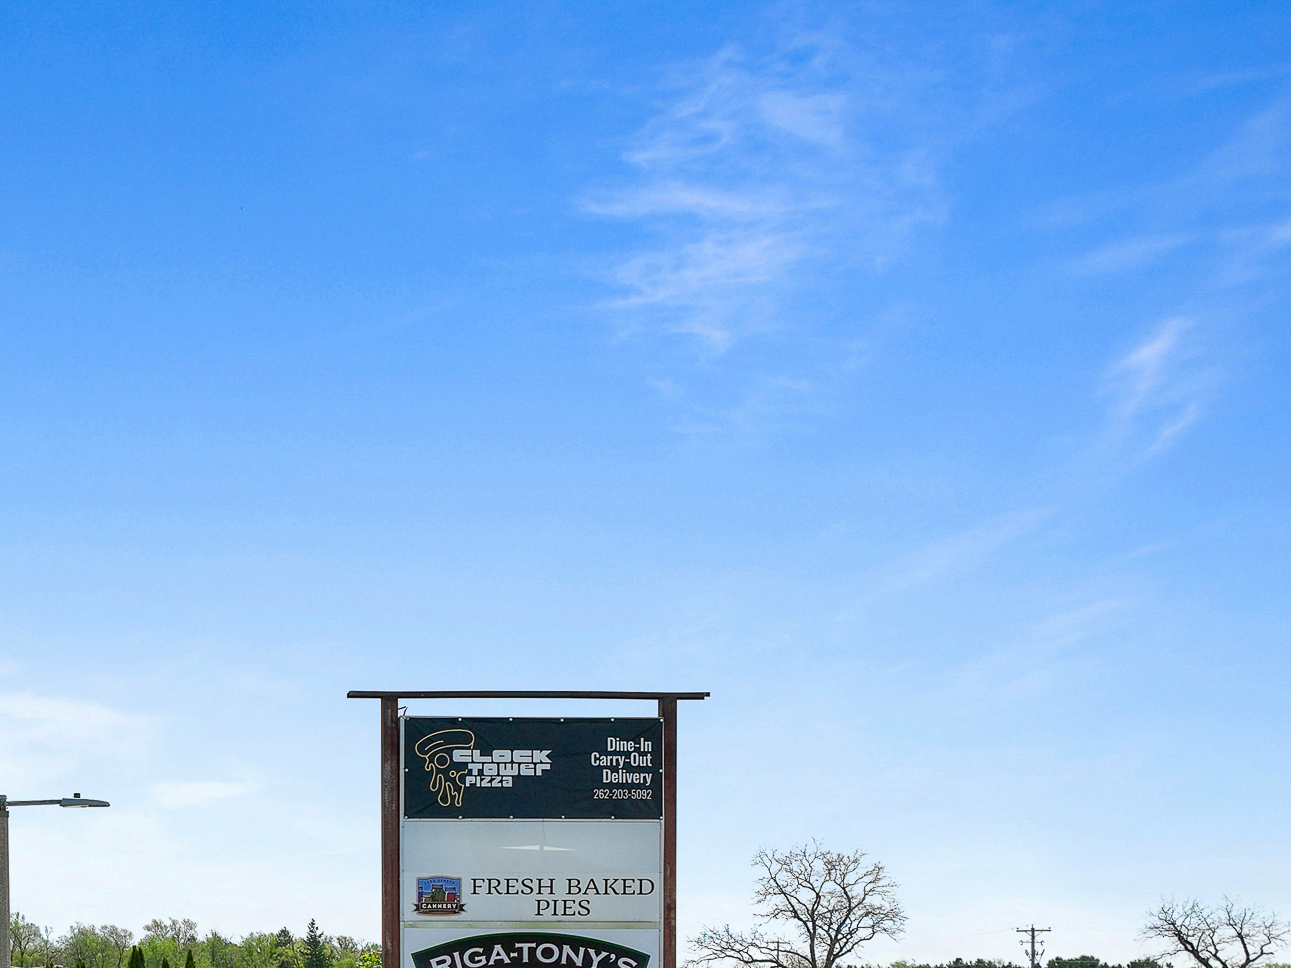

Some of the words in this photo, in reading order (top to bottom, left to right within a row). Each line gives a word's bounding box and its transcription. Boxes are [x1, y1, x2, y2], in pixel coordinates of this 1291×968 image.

[607, 737, 652, 752] Dine-In
[452, 749, 553, 763] CLOCK
[591, 752, 653, 769] Carry-Out
[602, 769, 653, 786] Delivery
[593, 788, 653, 800] 262-203-5092
[470, 878, 556, 896] FRESH
[565, 878, 656, 896] BAKED
[534, 899, 592, 917] PIES
